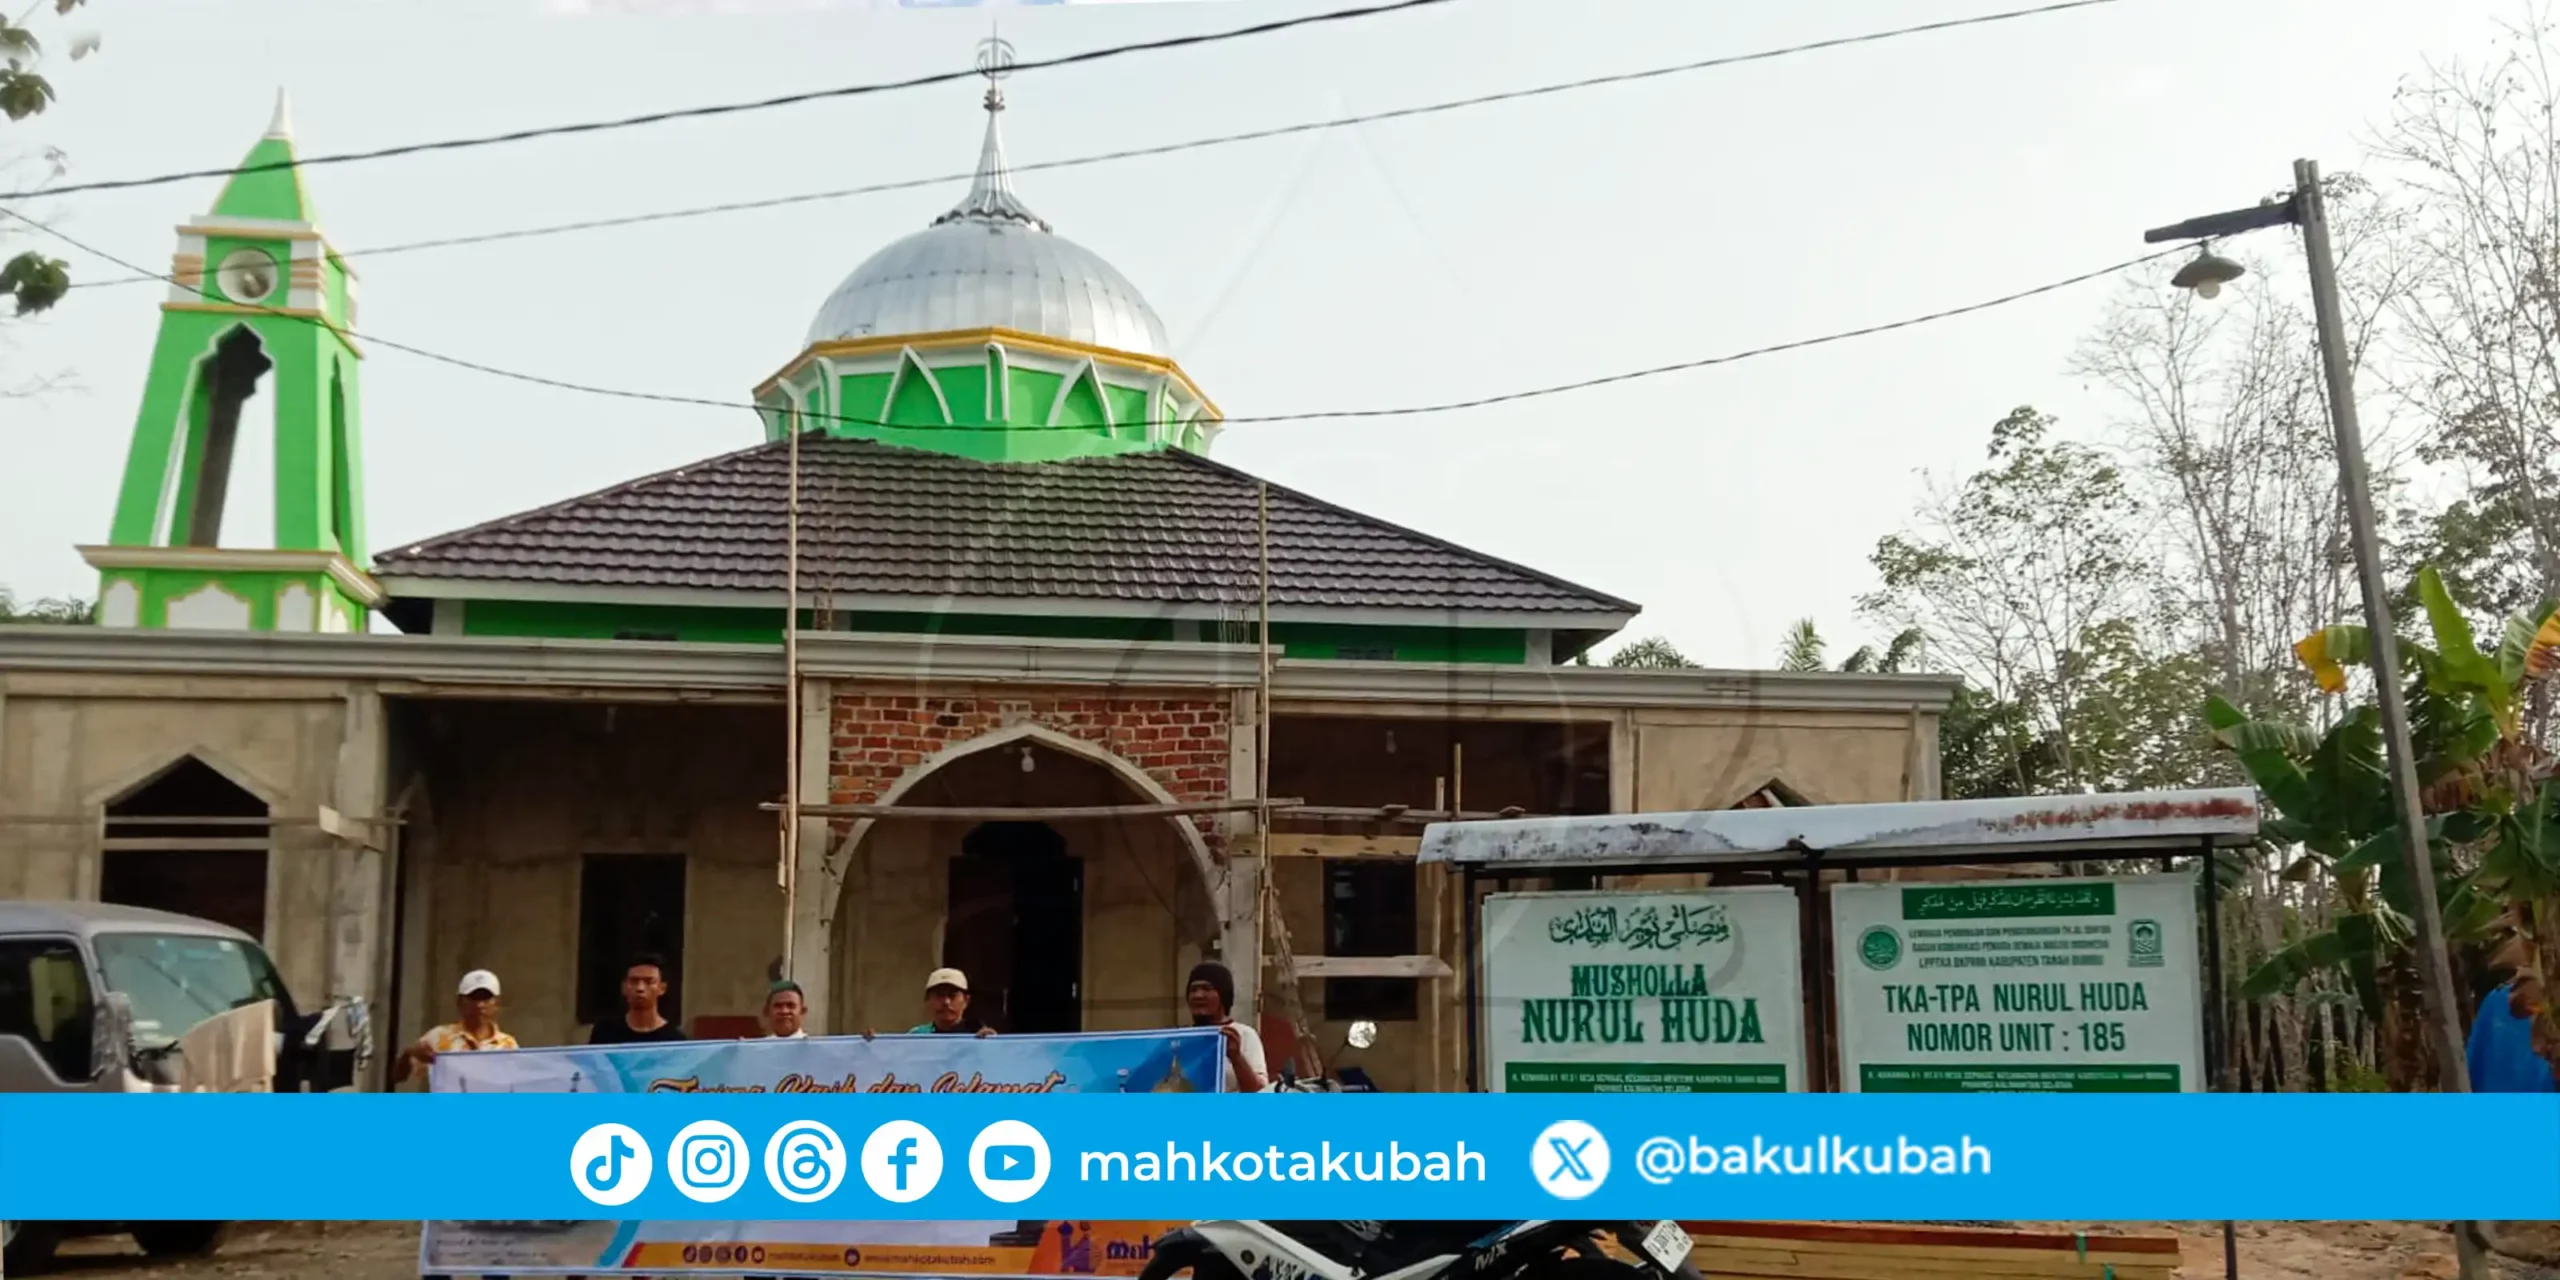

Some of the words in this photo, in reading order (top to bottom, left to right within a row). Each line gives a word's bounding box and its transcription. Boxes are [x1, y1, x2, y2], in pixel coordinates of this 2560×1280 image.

[1571, 964, 1709, 997] MUSHOLLA
[1882, 984, 1980, 1013] TKA-TPA
[1993, 983, 2074, 1012] NURUL
[2079, 982, 2149, 1011] HUDA
[1521, 998, 1645, 1044] NURUL
[1659, 998, 1765, 1044] HUDA
[1907, 1023, 1993, 1052] NOMOR
[1999, 1022, 2055, 1052] UNIT
[2062, 1030, 2069, 1052] :
[2077, 1022, 2126, 1052] 185
